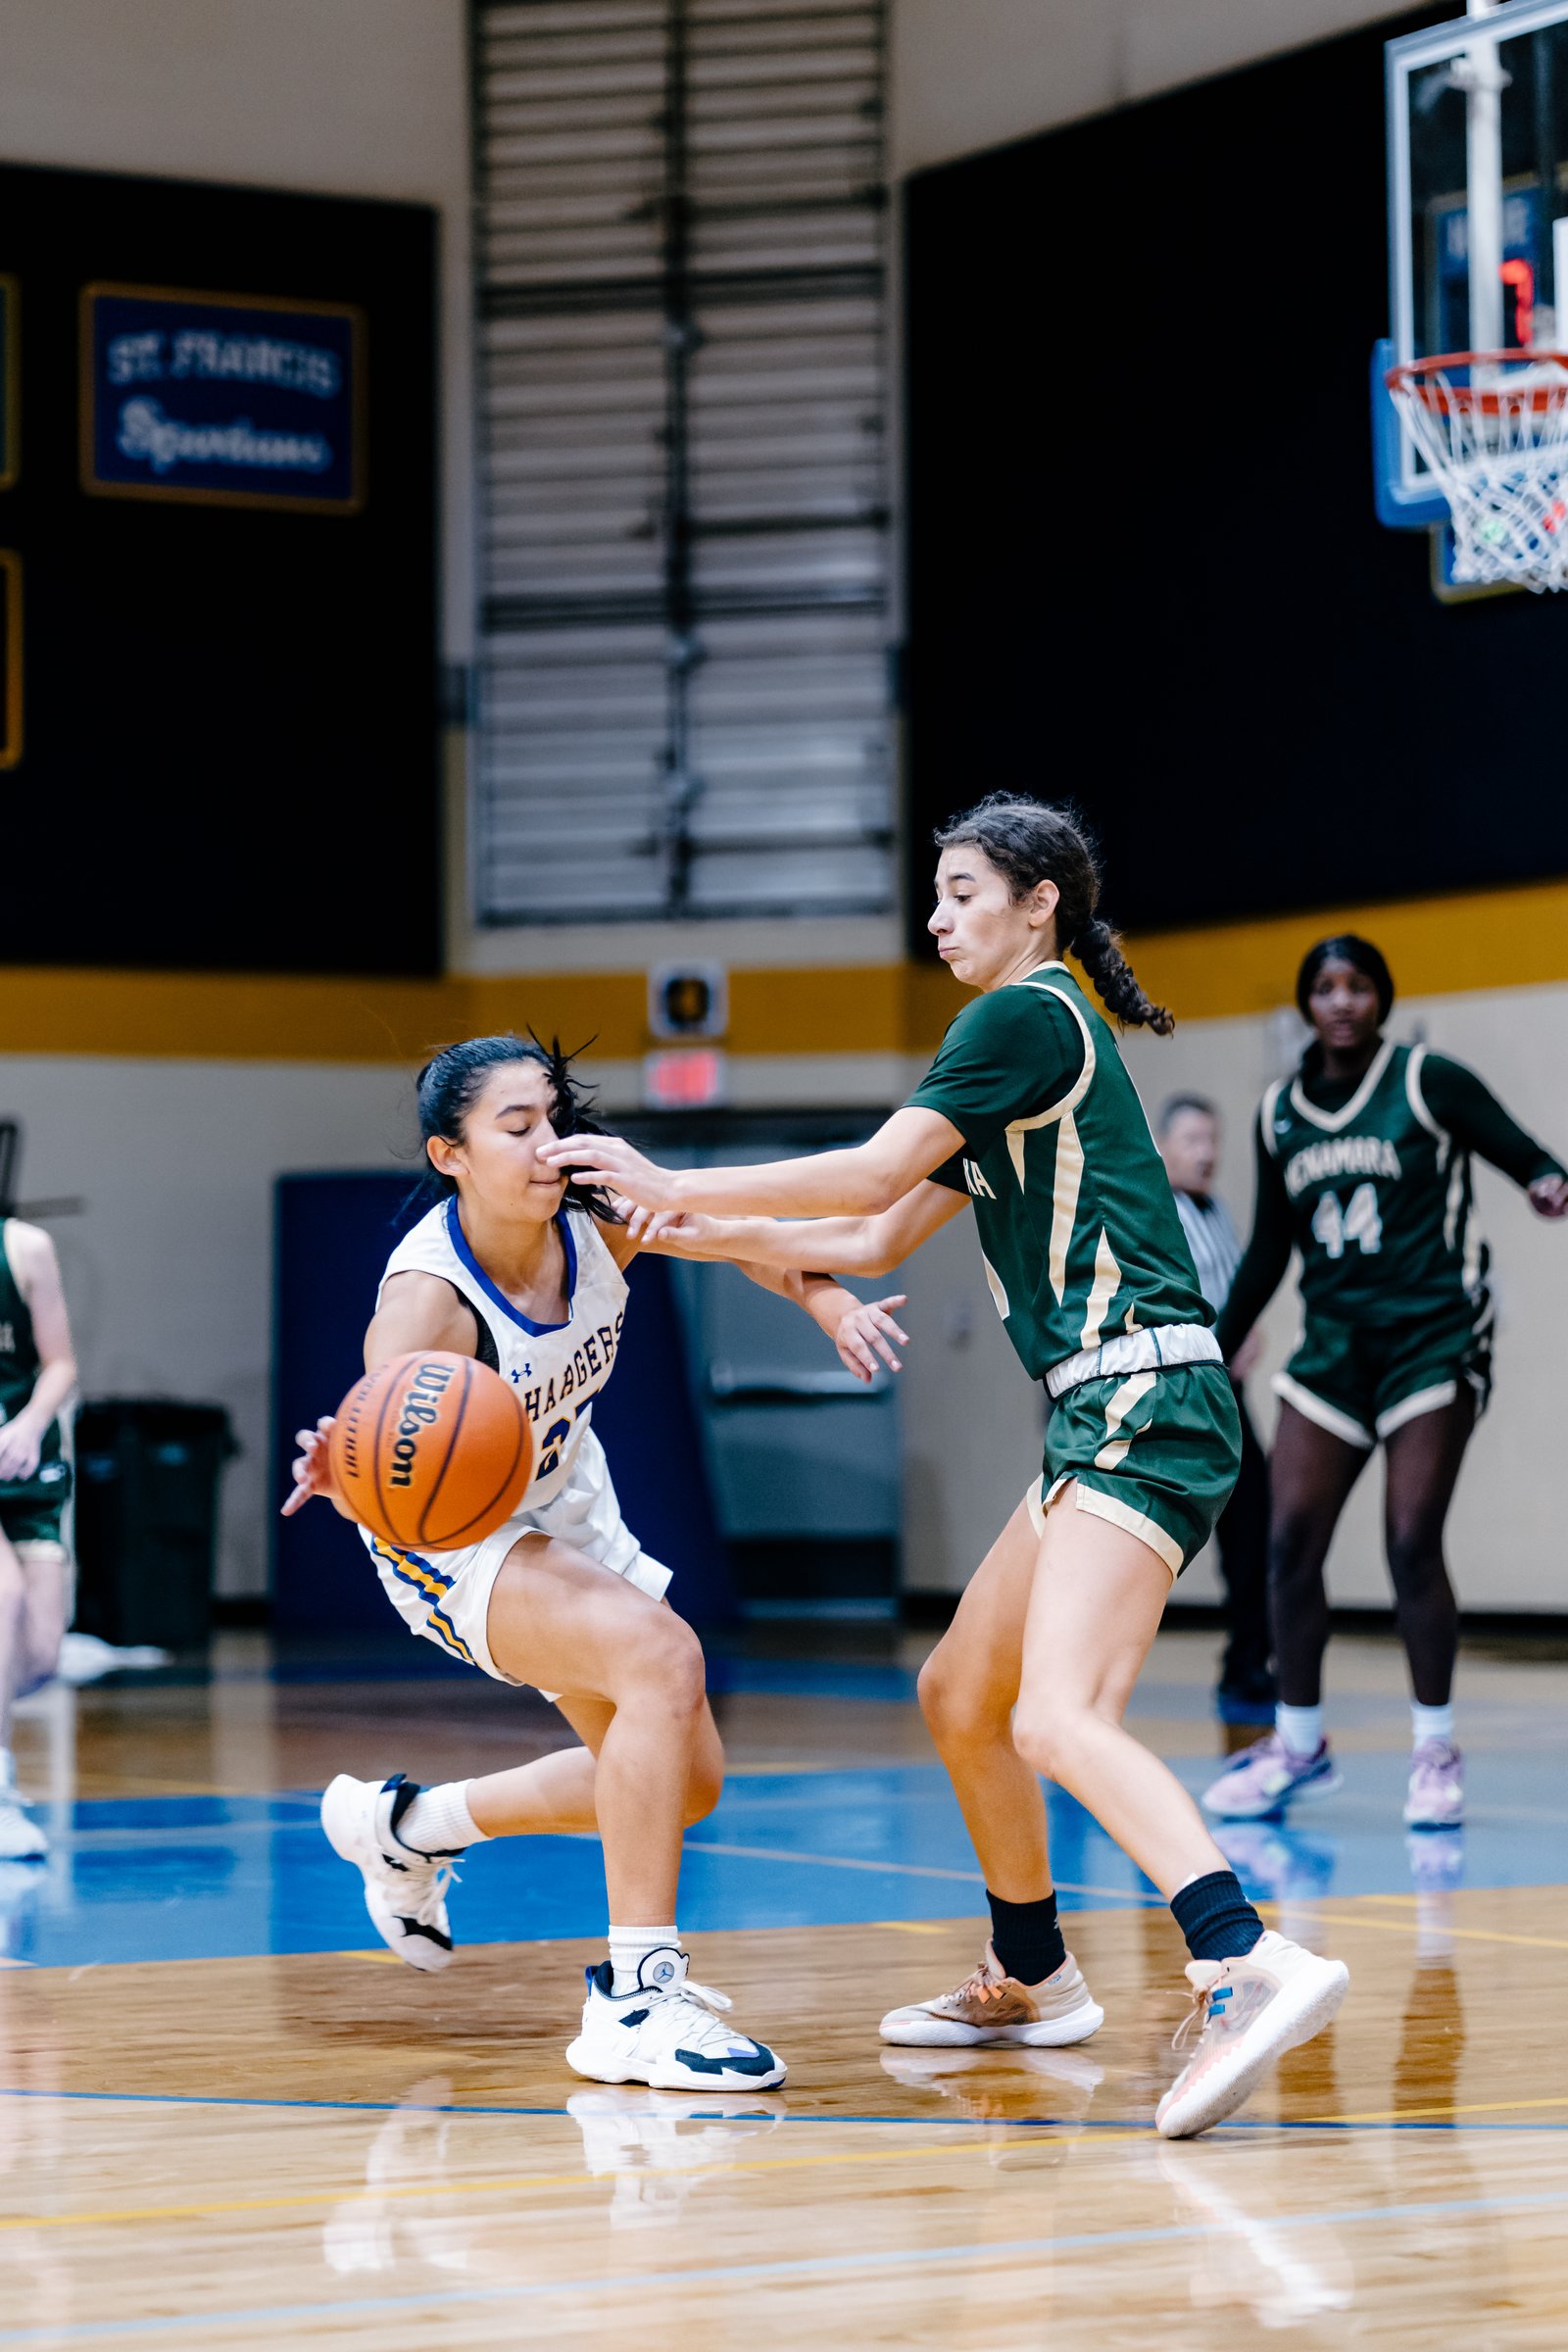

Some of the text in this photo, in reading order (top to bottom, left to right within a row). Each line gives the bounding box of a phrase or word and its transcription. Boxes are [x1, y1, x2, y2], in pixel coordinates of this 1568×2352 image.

[171, 330, 340, 397] FRANCIS
[119, 396, 331, 475] Spartans
[1312, 1184, 1383, 1260] 44
[522, 1311, 623, 1422] HARGERS
[389, 1361, 456, 1488] Wilson
